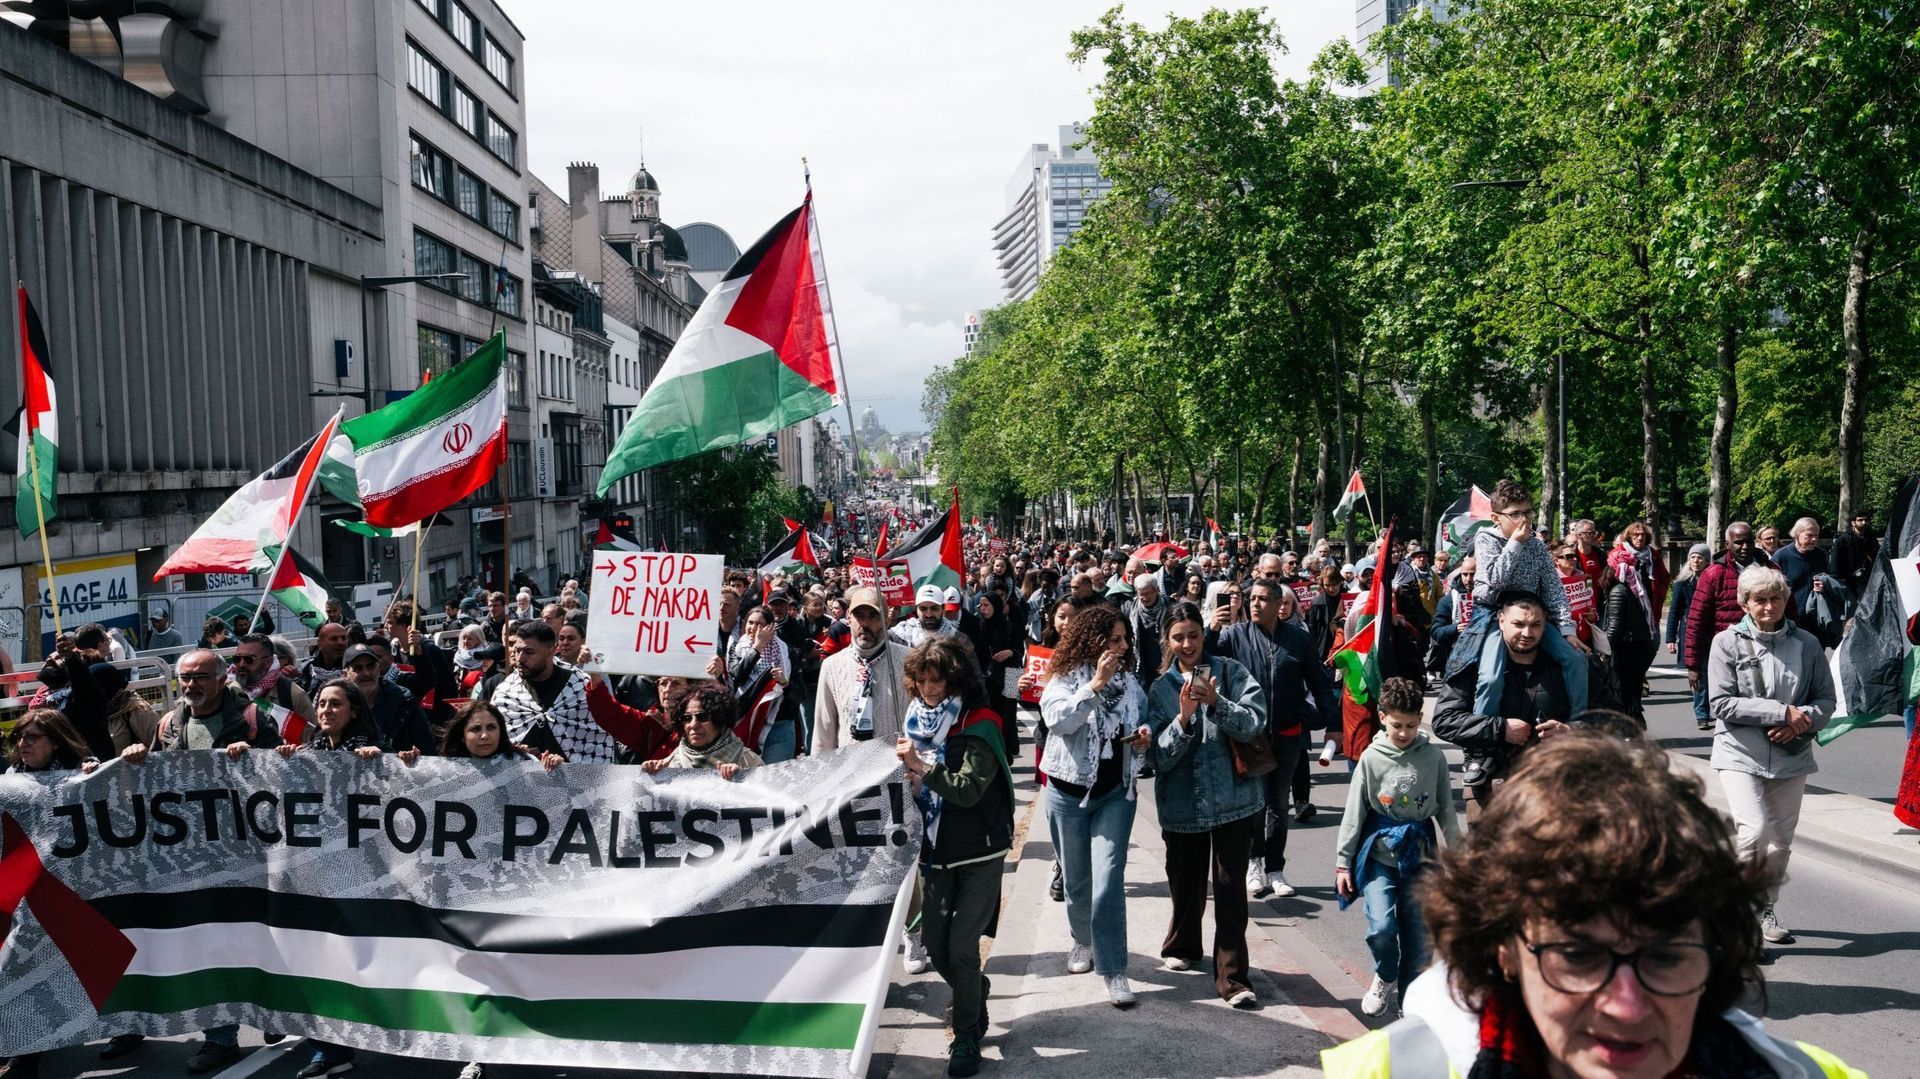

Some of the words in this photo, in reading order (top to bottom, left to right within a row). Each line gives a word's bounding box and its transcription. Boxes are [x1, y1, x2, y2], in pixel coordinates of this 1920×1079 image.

[346, 340, 354, 376] P
[768, 438, 776, 449] P
[205, 573, 239, 590] SSAGE
[623, 554, 697, 585] STOP
[107, 577, 128, 606] 44
[611, 585, 636, 616] DE
[641, 586, 711, 621] NAKBA
[1565, 582, 1584, 595] Stop
[635, 621, 669, 654] NU
[52, 788, 323, 859] JUSTICE
[347, 794, 478, 860] FOR
[502, 782, 909, 868] PALESTINE!
